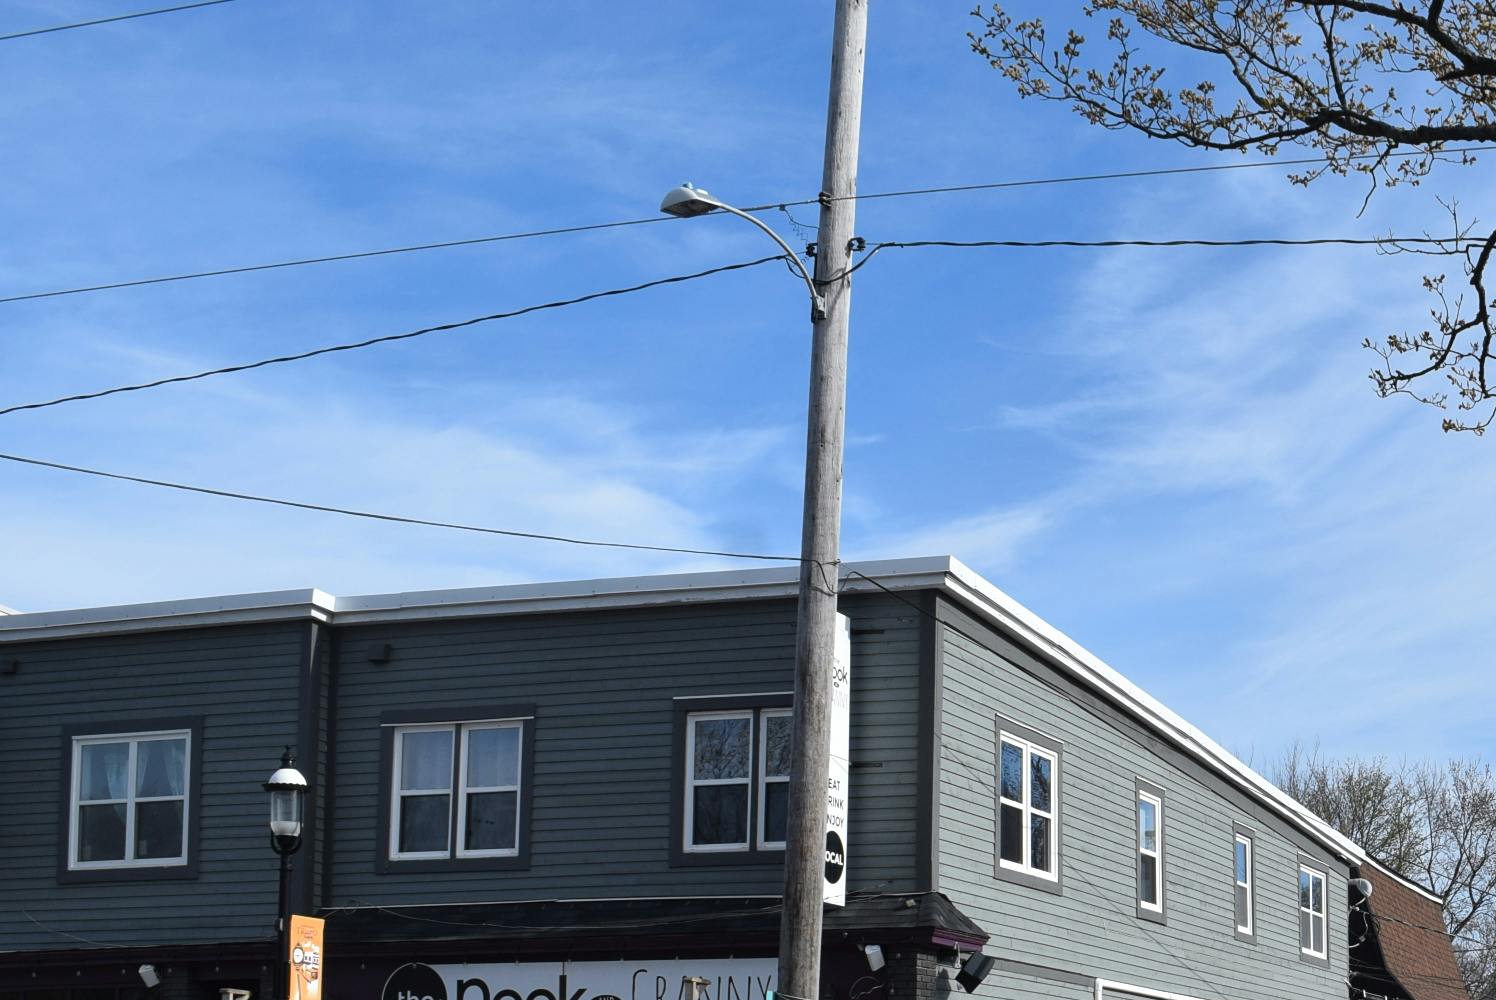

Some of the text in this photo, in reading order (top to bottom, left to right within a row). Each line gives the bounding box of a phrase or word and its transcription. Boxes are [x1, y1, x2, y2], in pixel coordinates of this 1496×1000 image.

[828, 778, 841, 791] EAT
[828, 795, 844, 809] RINK
[827, 814, 844, 827] NJOY
[825, 851, 844, 865] OCAL
